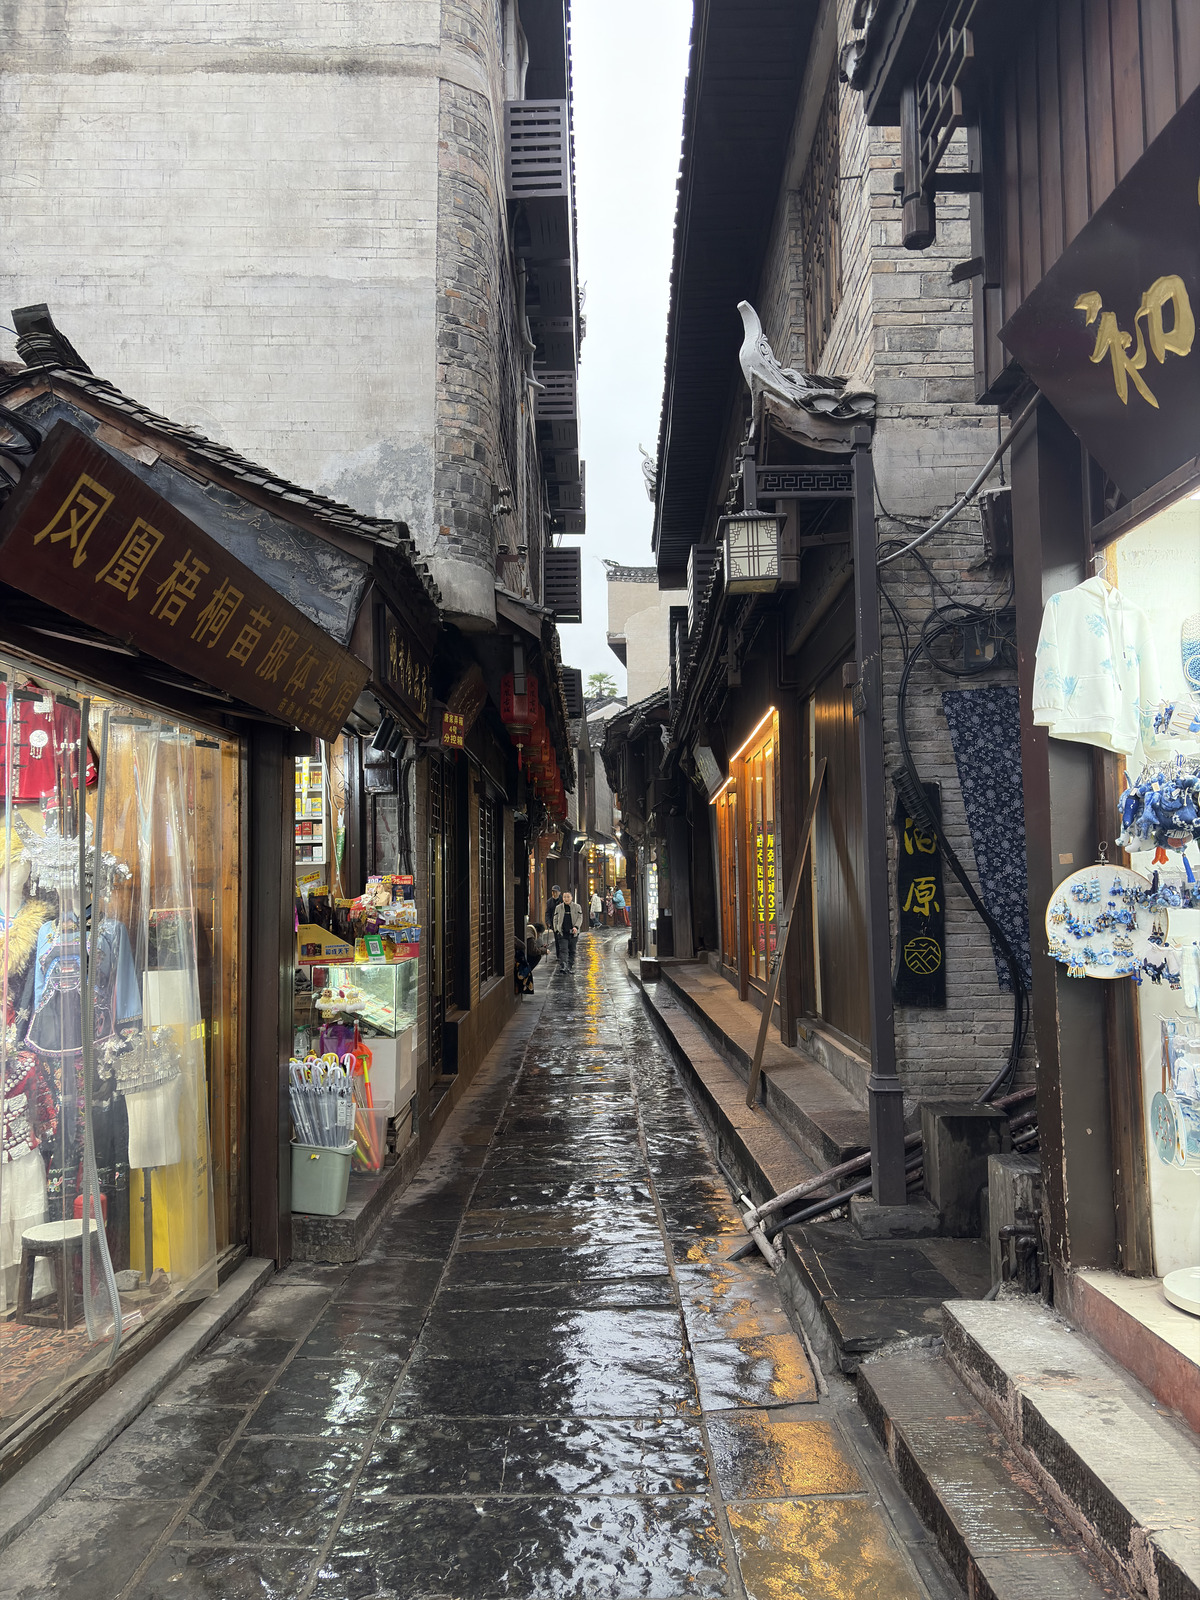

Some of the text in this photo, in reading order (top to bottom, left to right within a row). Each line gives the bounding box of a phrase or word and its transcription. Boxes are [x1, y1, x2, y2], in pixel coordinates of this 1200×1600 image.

[33, 472, 357, 721] 凤凰梧桐苗服体验馆
